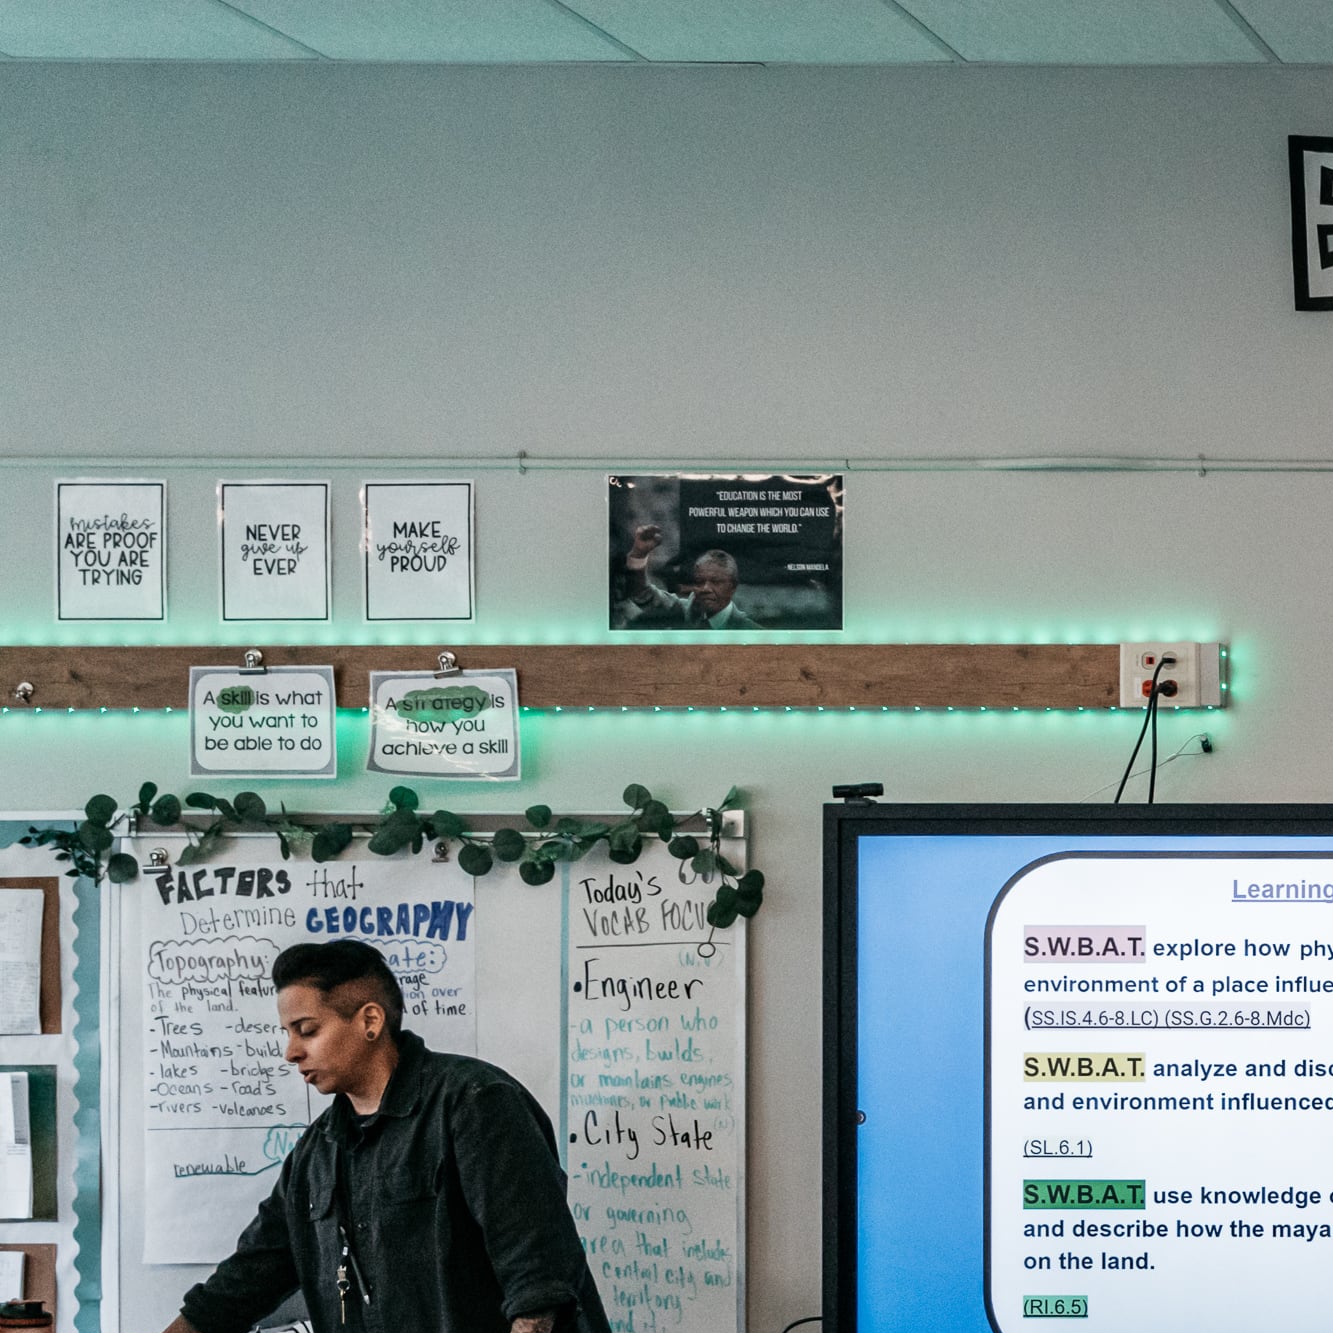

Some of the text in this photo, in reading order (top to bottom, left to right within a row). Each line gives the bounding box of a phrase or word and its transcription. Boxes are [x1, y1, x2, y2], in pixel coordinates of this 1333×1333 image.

[758, 490, 766, 501] IS
[768, 490, 782, 501] THE
[782, 490, 802, 501] MOST
[688, 506, 830, 518] POWERFUL WEAPON WHICH YOU CAN USE
[70, 513, 156, 533] mistakes
[394, 521, 441, 538] MAKE
[716, 523, 726, 534] TO
[726, 523, 755, 534] CHANGE
[756, 523, 770, 534] THE
[65, 532, 157, 549] ARE PROOF
[247, 525, 301, 542] NEVER
[70, 549, 149, 567] YOU ARE
[241, 542, 308, 563] give up
[377, 535, 460, 565] yourself
[254, 559, 296, 575] EVER
[391, 556, 446, 572] PROUD
[79, 569, 142, 585] TRYING
[203, 688, 322, 707] A skill is what
[386, 698, 397, 710] A
[490, 694, 504, 708] is
[209, 713, 317, 731] you want to
[406, 719, 485, 735] how you
[205, 736, 322, 750] be able to do
[382, 739, 509, 755] achieve a skill
[154, 865, 364, 905] FACTORS that
[579, 871, 661, 903] Today's
[180, 900, 476, 942] Determine GEOGRAPHY
[583, 899, 708, 936] VOCAB FOCU
[1024, 936, 1145, 957] S.W.B.A.T.
[1154, 939, 1235, 960] explore
[1245, 939, 1290, 956] how
[154, 949, 270, 979] Topography:
[585, 957, 703, 1012] Engineer
[1024, 976, 1158, 992] environment
[1166, 976, 1187, 992] of
[1193, 980, 1204, 992] a
[1213, 976, 1268, 996] place
[1025, 1007, 1311, 1030] (SS.IS.4.6-8.LC) (SS.G.2.6-8.Mdc)
[585, 1110, 712, 1160] City State
[1023, 1140, 1092, 1158] (SL.6.1)
[174, 1155, 248, 1177] renewable
[1024, 1184, 1145, 1204] S.W.B.A.T.
[1154, 1191, 1192, 1203] use
[1201, 1187, 1321, 1208] knowledge
[1022, 1297, 1089, 1318] (RI.6.5)
